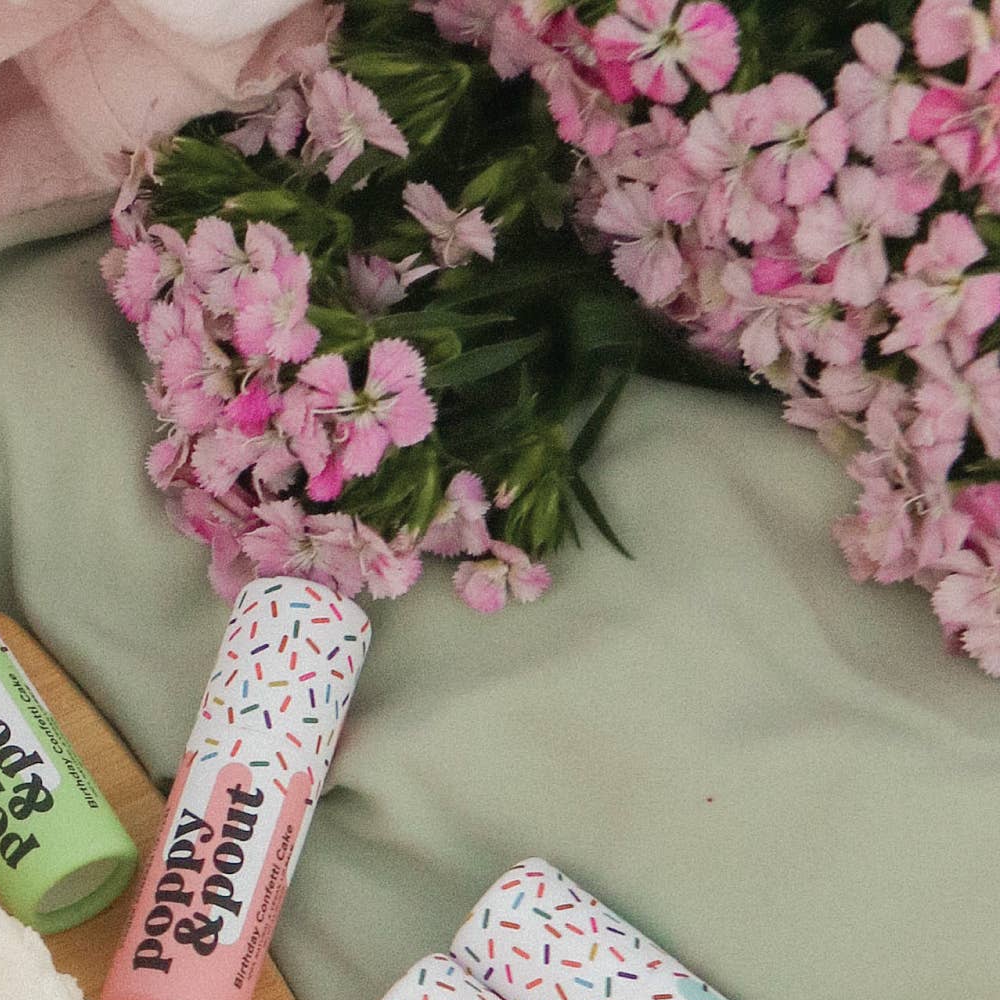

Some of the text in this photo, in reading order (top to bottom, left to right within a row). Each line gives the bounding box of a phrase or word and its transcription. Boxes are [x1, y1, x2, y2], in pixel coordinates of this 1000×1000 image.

[8, 672, 31, 704] Cake
[29, 705, 64, 755] Confetti
[61, 757, 99, 809] Birthday
[132, 808, 215, 975] poppy
[233, 927, 262, 990] Birthday
[256, 862, 281, 924] Confetti
[275, 823, 294, 862] Cake
